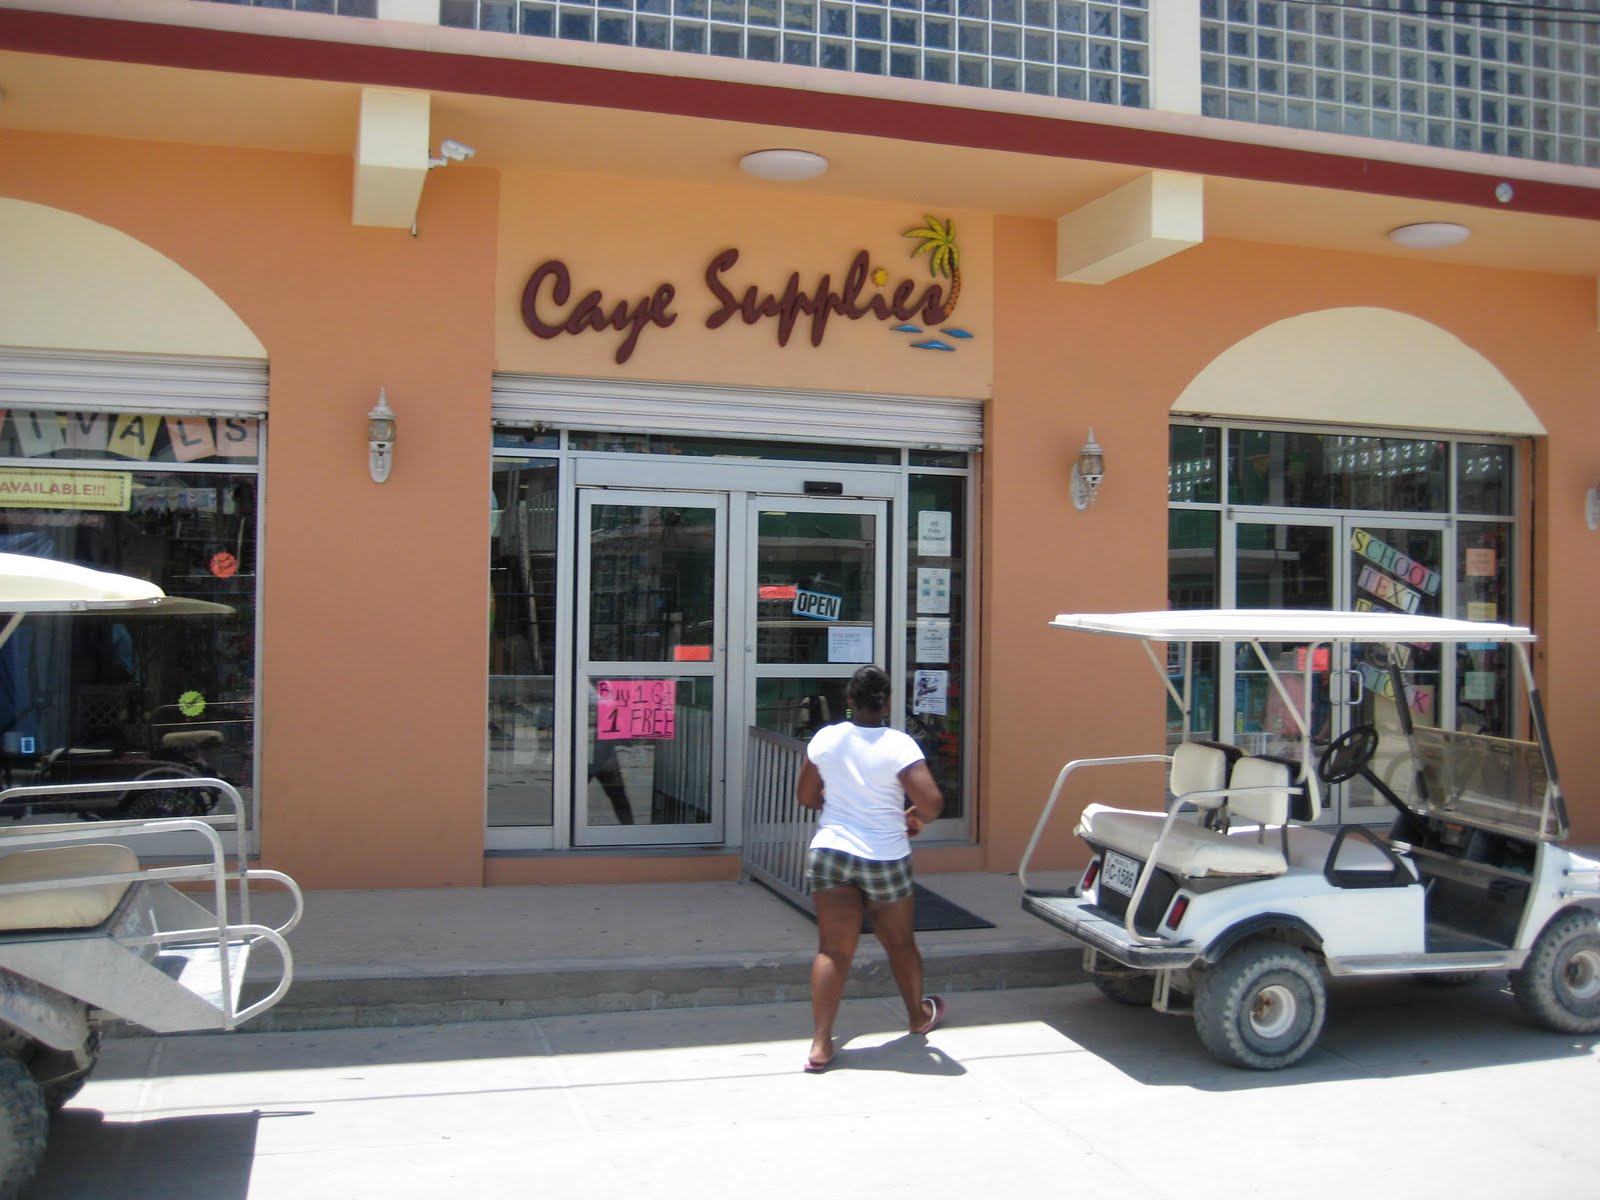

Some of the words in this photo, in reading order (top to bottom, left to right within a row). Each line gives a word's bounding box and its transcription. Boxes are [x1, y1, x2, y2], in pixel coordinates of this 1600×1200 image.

[520, 259, 678, 365] Caye
[705, 248, 950, 348] Supplies
[1354, 531, 1437, 594] SCHOOL
[797, 592, 838, 618] OPEN
[1363, 566, 1421, 612] TEXT
[602, 708, 621, 733] 1
[630, 708, 673, 735] FREE
